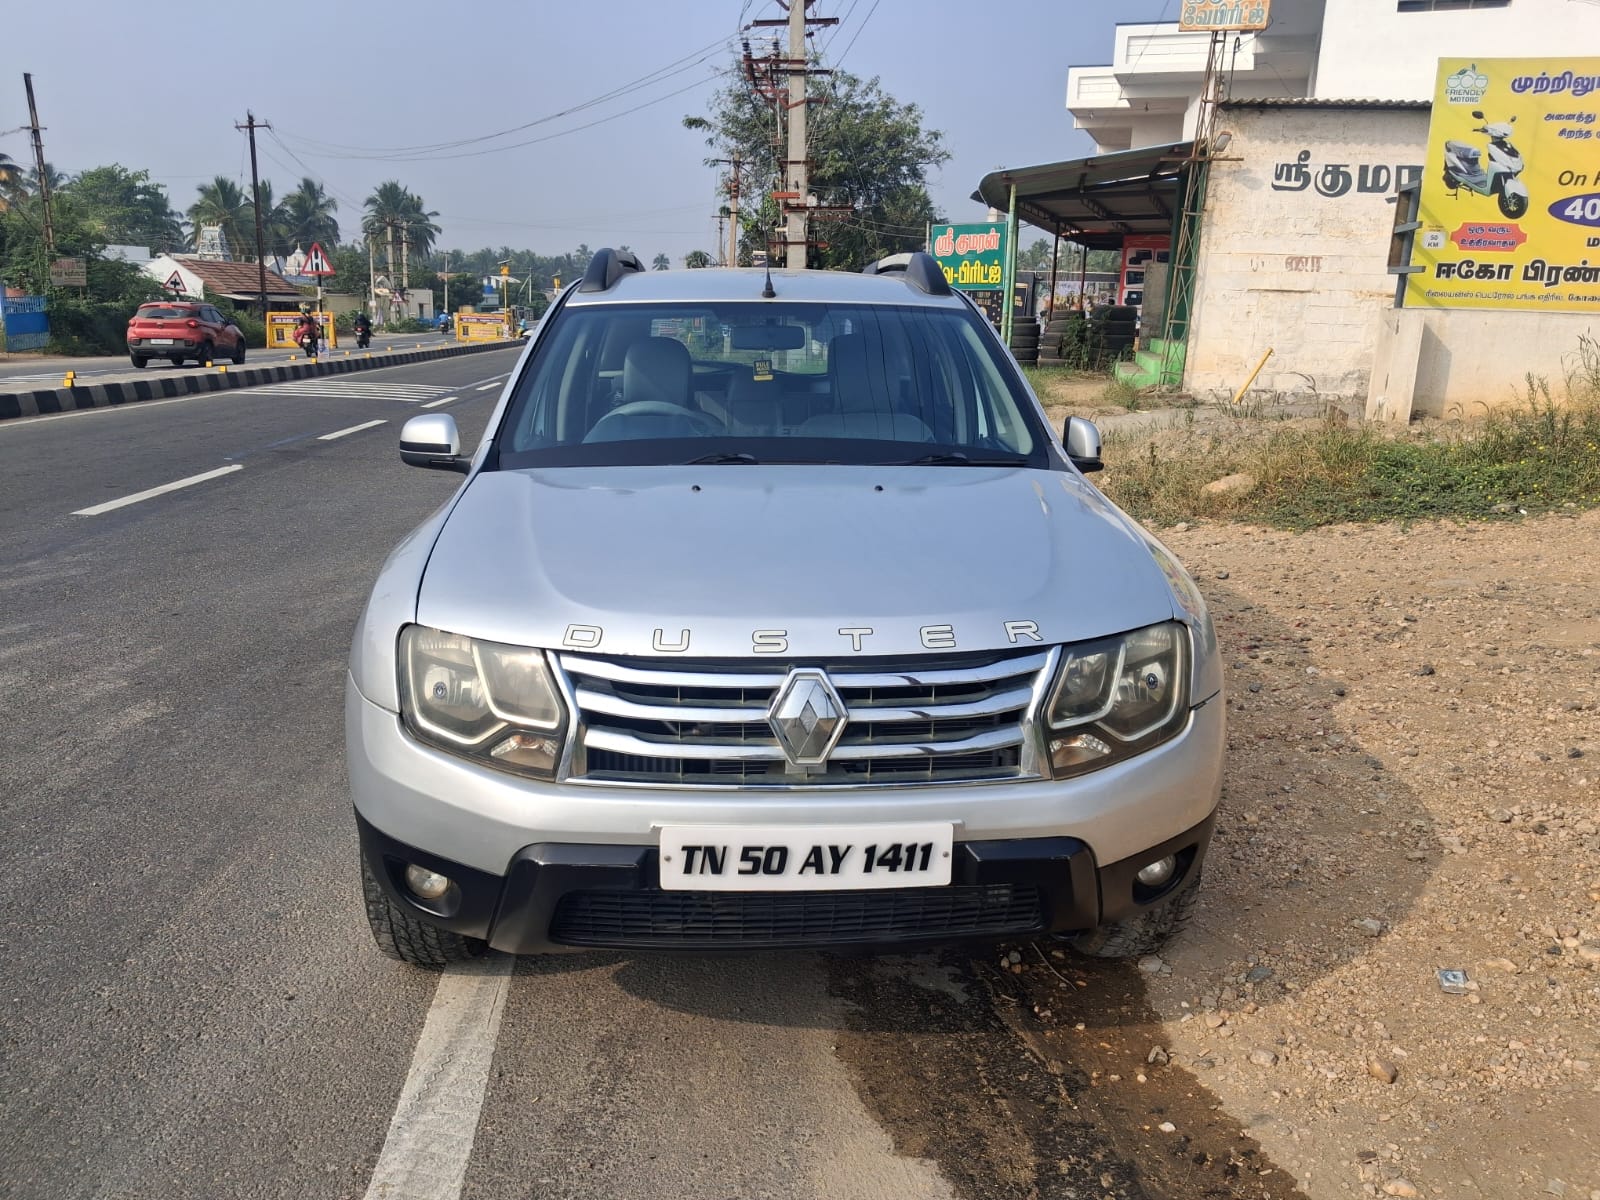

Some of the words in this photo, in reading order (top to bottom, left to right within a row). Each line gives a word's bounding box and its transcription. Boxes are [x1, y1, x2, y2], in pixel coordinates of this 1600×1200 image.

[1511, 71, 1600, 96] முற்றிலு
[1558, 170, 1587, 187] On
[562, 620, 1044, 653] DUSTER
[681, 845, 727, 875] TN
[738, 846, 788, 875] 50
[798, 845, 854, 875] AY
[862, 842, 934, 873] 1411
